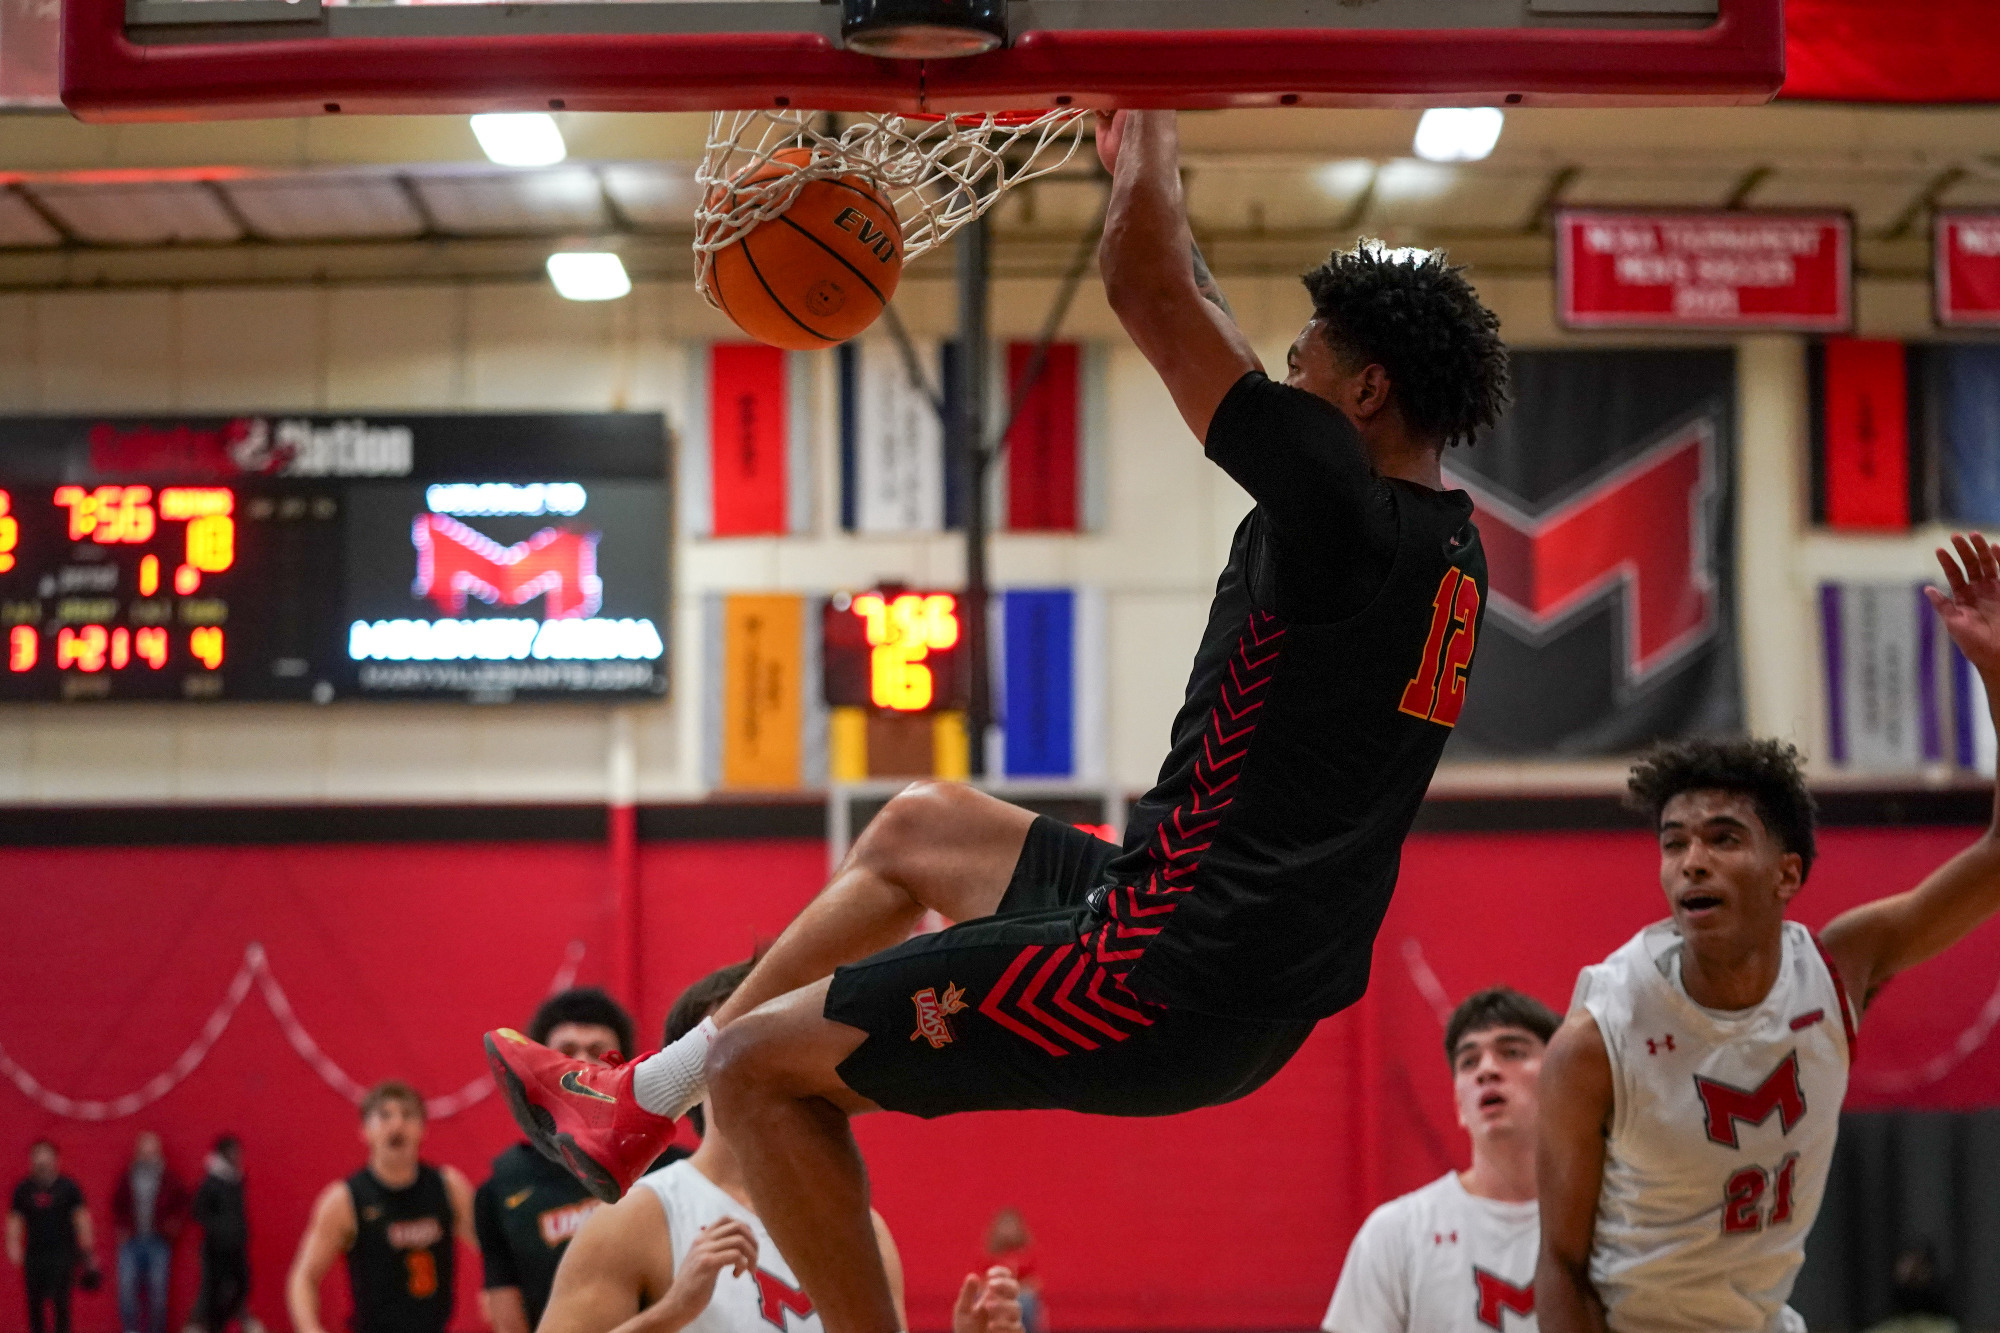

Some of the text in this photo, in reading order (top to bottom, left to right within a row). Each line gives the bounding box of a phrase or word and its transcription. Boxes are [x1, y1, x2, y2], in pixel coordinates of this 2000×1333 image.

[54, 485, 155, 543] 7:56
[1398, 566, 1479, 727] 12
[914, 989, 951, 1048] UMSL
[1721, 1151, 1801, 1235] 21
